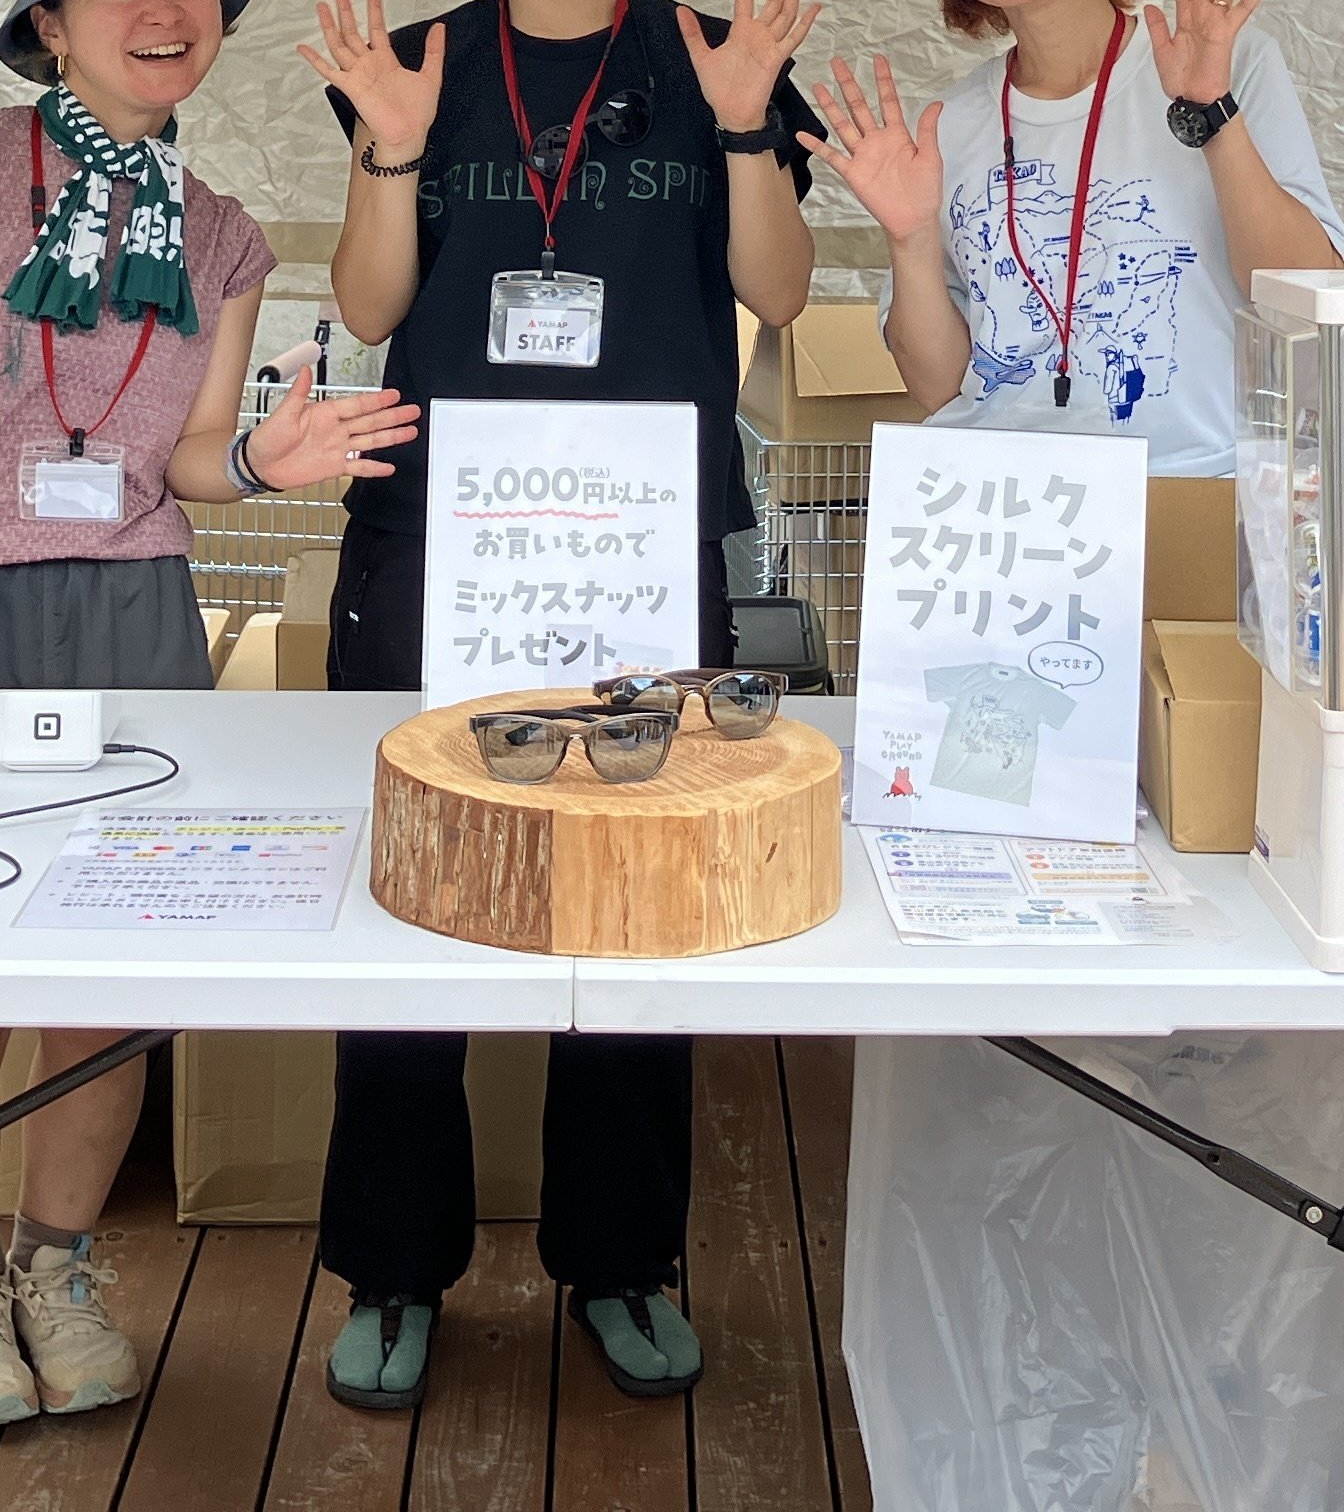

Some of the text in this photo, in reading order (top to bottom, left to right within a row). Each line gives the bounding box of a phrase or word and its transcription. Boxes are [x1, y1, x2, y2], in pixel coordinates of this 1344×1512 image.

[538, 321, 568, 329] YAMAP
[517, 334, 576, 352] STAFF
[916, 467, 1087, 528] シルク
[473, 527, 656, 560] お買いもので
[889, 526, 1113, 580] スクリーン
[454, 580, 668, 615] ミックスナッツ
[897, 578, 1101, 641] プリント
[453, 628, 617, 666] プレゼント
[1039, 656, 1093, 670] やってます
[882, 730, 922, 741] YAMAP
[889, 740, 913, 751] PLAY
